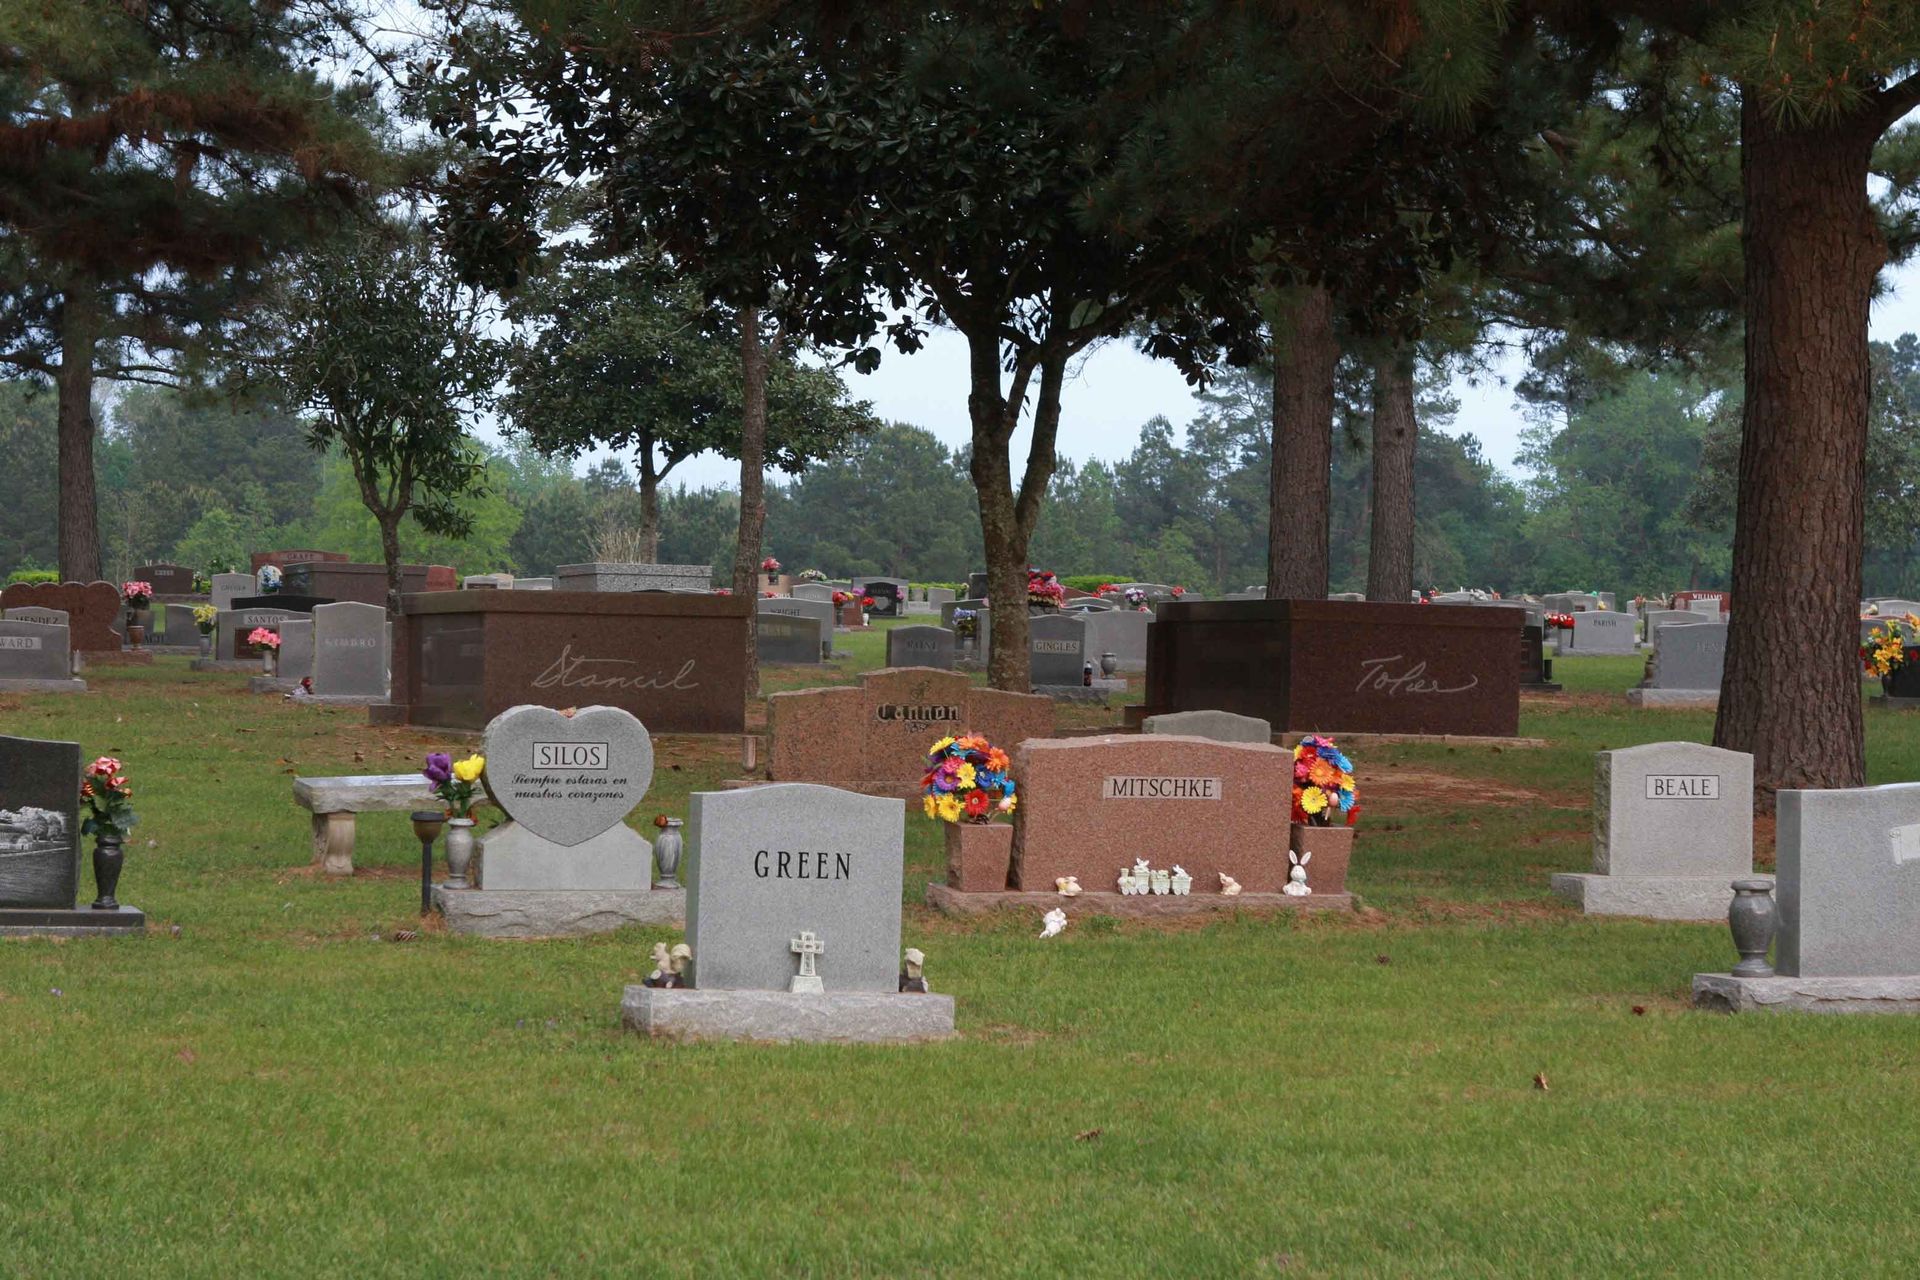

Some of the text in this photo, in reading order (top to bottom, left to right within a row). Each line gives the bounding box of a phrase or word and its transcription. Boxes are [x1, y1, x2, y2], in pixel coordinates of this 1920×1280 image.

[1692, 593, 1723, 601] WILLIAMS
[248, 615, 284, 624] SANTOS
[1593, 619, 1617, 627] PARISH
[1035, 642, 1077, 651] GINGLES
[531, 644, 699, 689] Stancil
[876, 703, 960, 723] Cannon
[540, 746, 601, 766] SILOS
[512, 774, 561, 788] Siempre
[612, 777, 627, 785] en
[1112, 778, 1213, 798] MITSCHKE
[1654, 778, 1711, 797] BEALE
[515, 788, 624, 803] nuestros corazones
[754, 850, 851, 880] GREEN
